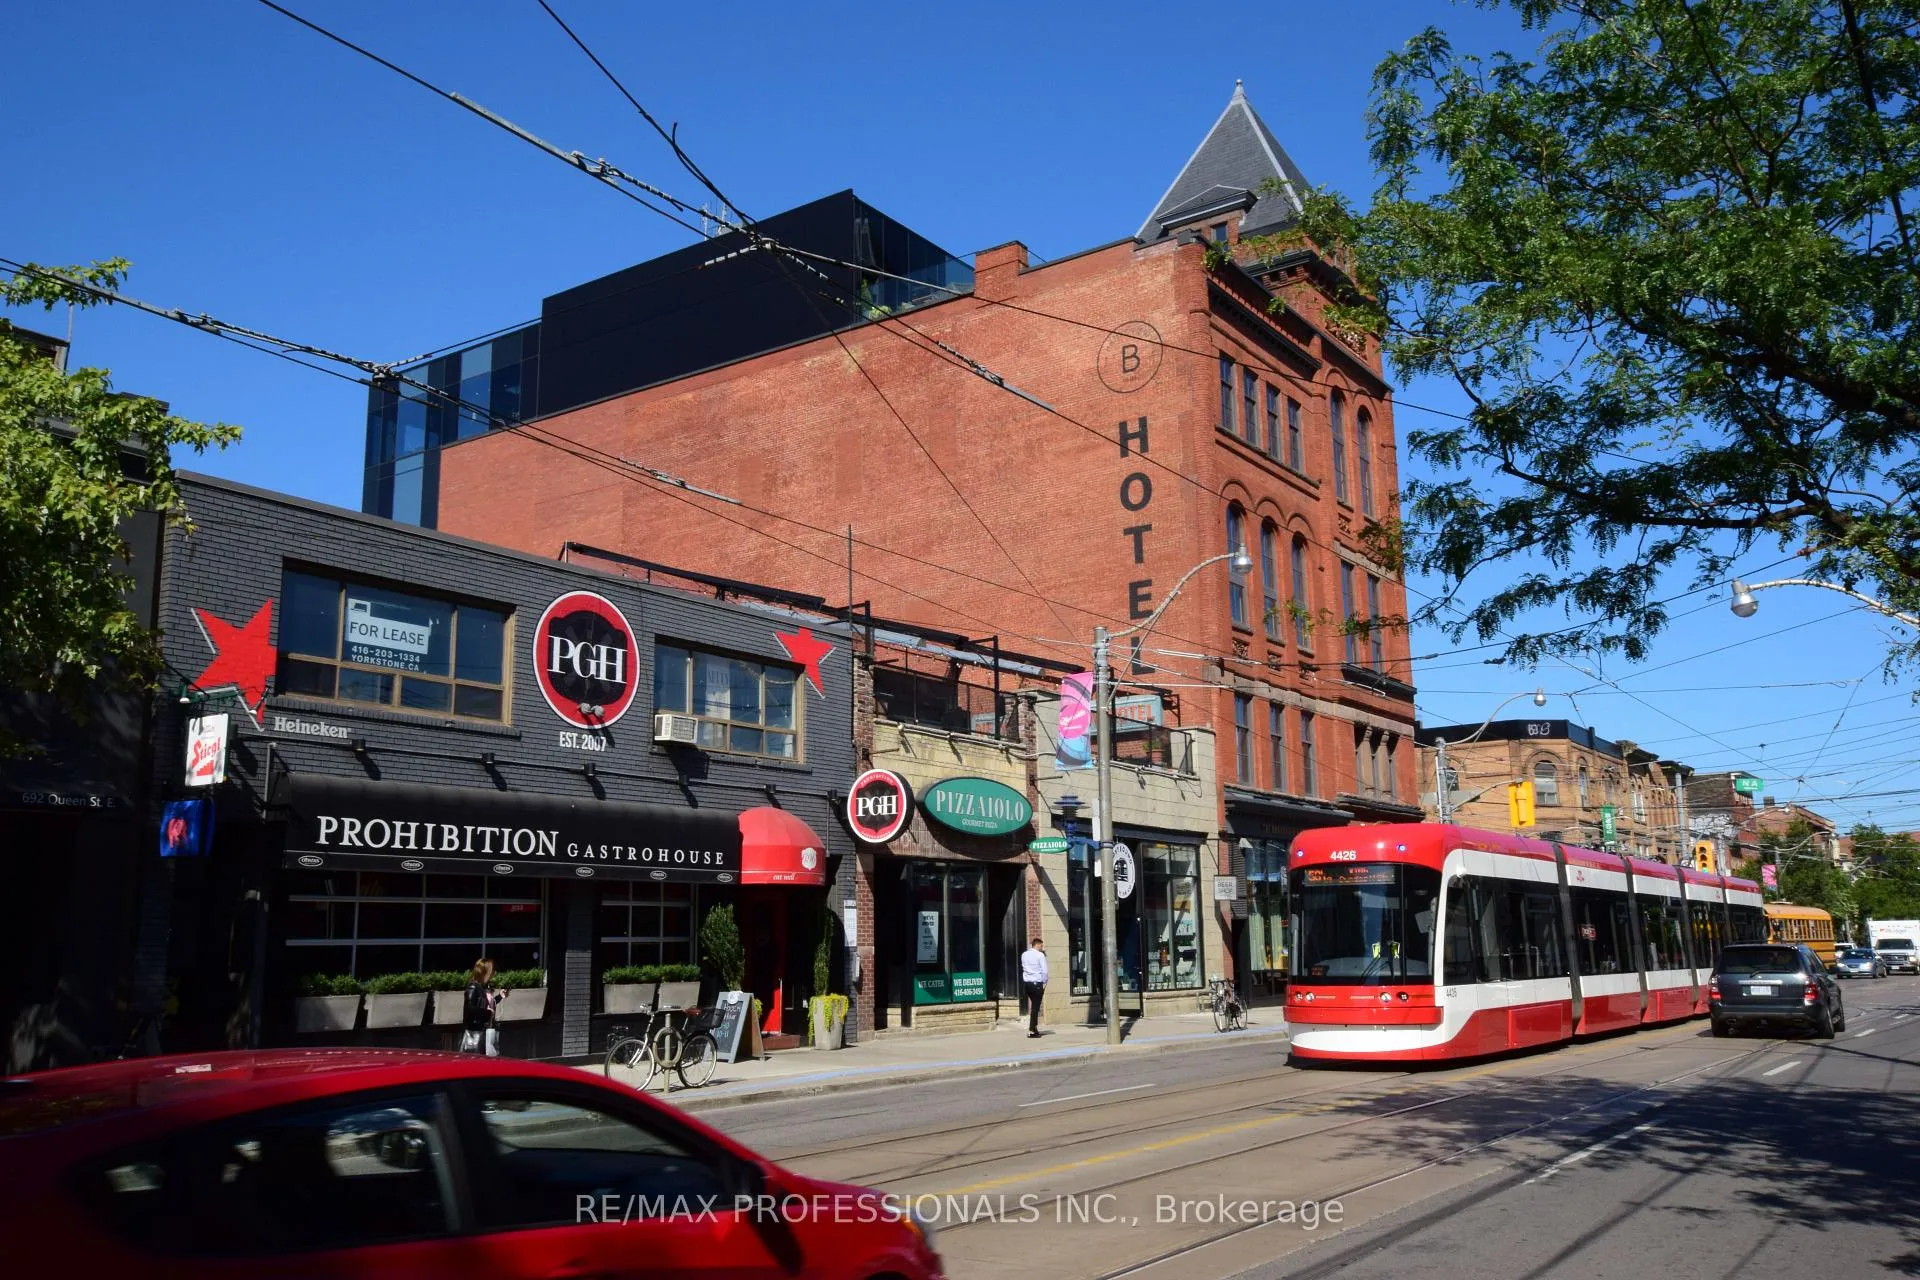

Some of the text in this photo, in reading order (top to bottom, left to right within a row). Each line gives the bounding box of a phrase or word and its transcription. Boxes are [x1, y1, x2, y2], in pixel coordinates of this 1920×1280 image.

[1122, 343, 1140, 374] B
[1118, 415, 1155, 676] HOTEL
[350, 621, 425, 646] FOR LEASE
[351, 645, 420, 662] 416-203-1334
[351, 654, 419, 671] YORKSTONE.CA
[546, 635, 628, 684] PGH
[274, 716, 349, 739] Heineken
[559, 731, 607, 752] EST. 2007
[22, 792, 44, 803] 692
[48, 793, 86, 806] Queen
[855, 794, 899, 817] PGH
[935, 789, 1025, 822] PIZZAIOLO
[315, 815, 724, 865] PROHIBITION GASTROHOUSE
[1032, 841, 1068, 849] PIZZAIOLO
[1330, 850, 1357, 861] 4426
[953, 977, 984, 987] WE DELIVER
